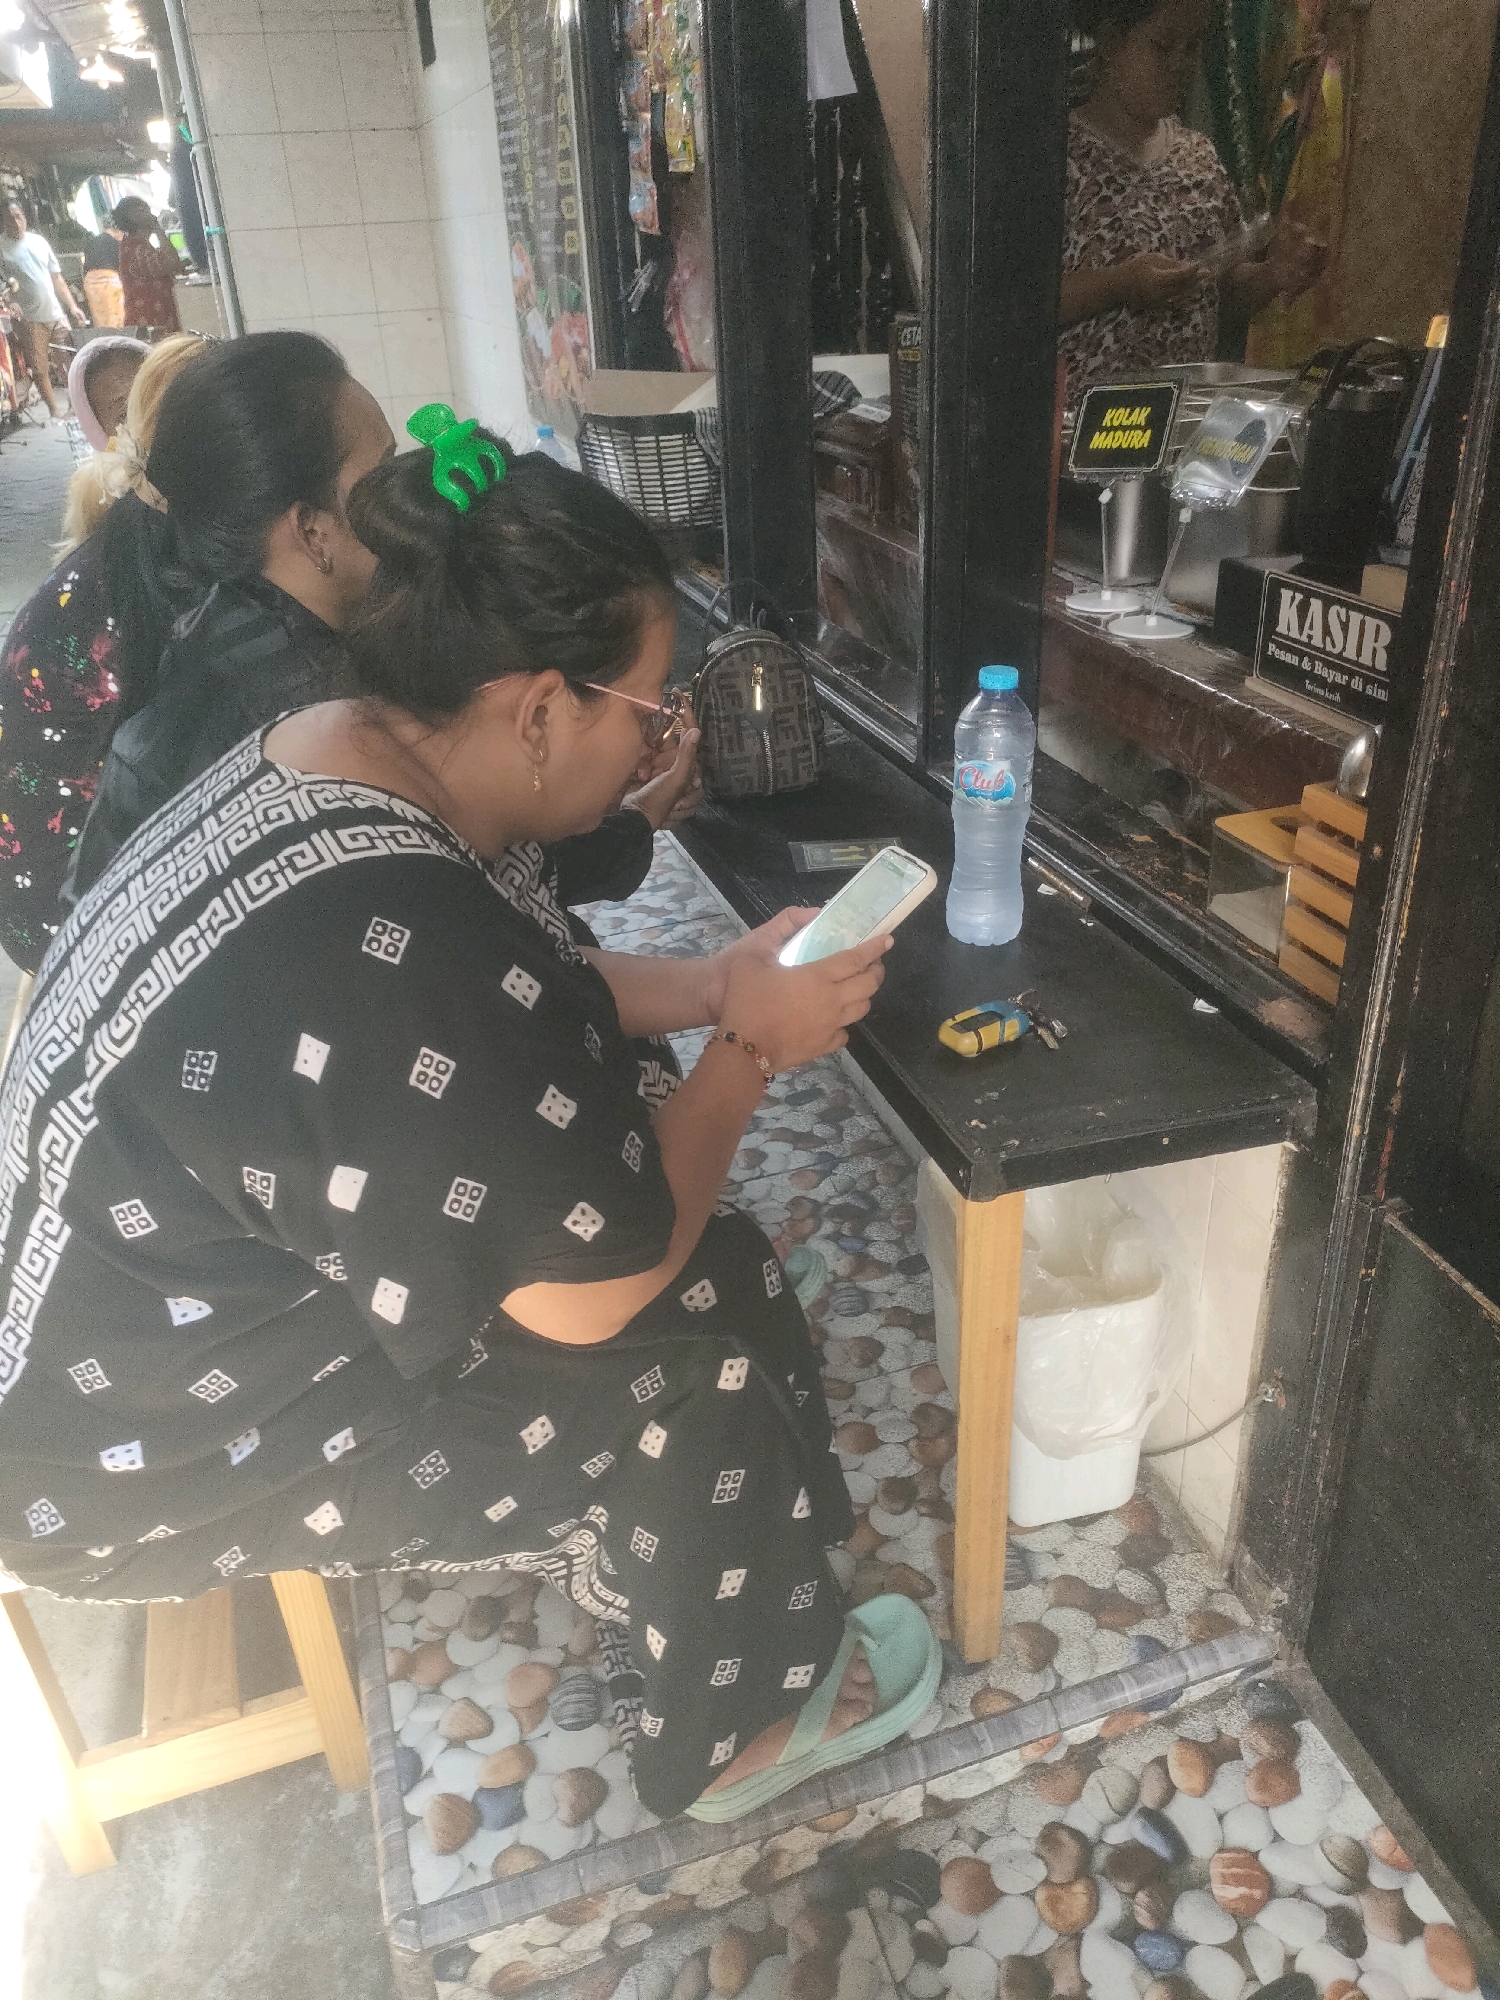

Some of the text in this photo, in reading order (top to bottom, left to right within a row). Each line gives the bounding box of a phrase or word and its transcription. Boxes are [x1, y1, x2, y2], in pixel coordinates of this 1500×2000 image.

[1102, 406, 1152, 427] KOLAK
[1089, 429, 1152, 449] MADURA
[1275, 587, 1392, 672] KASIR
[1267, 642, 1389, 702] Pesan & Bayar di sini
[959, 765, 1006, 792] Club
